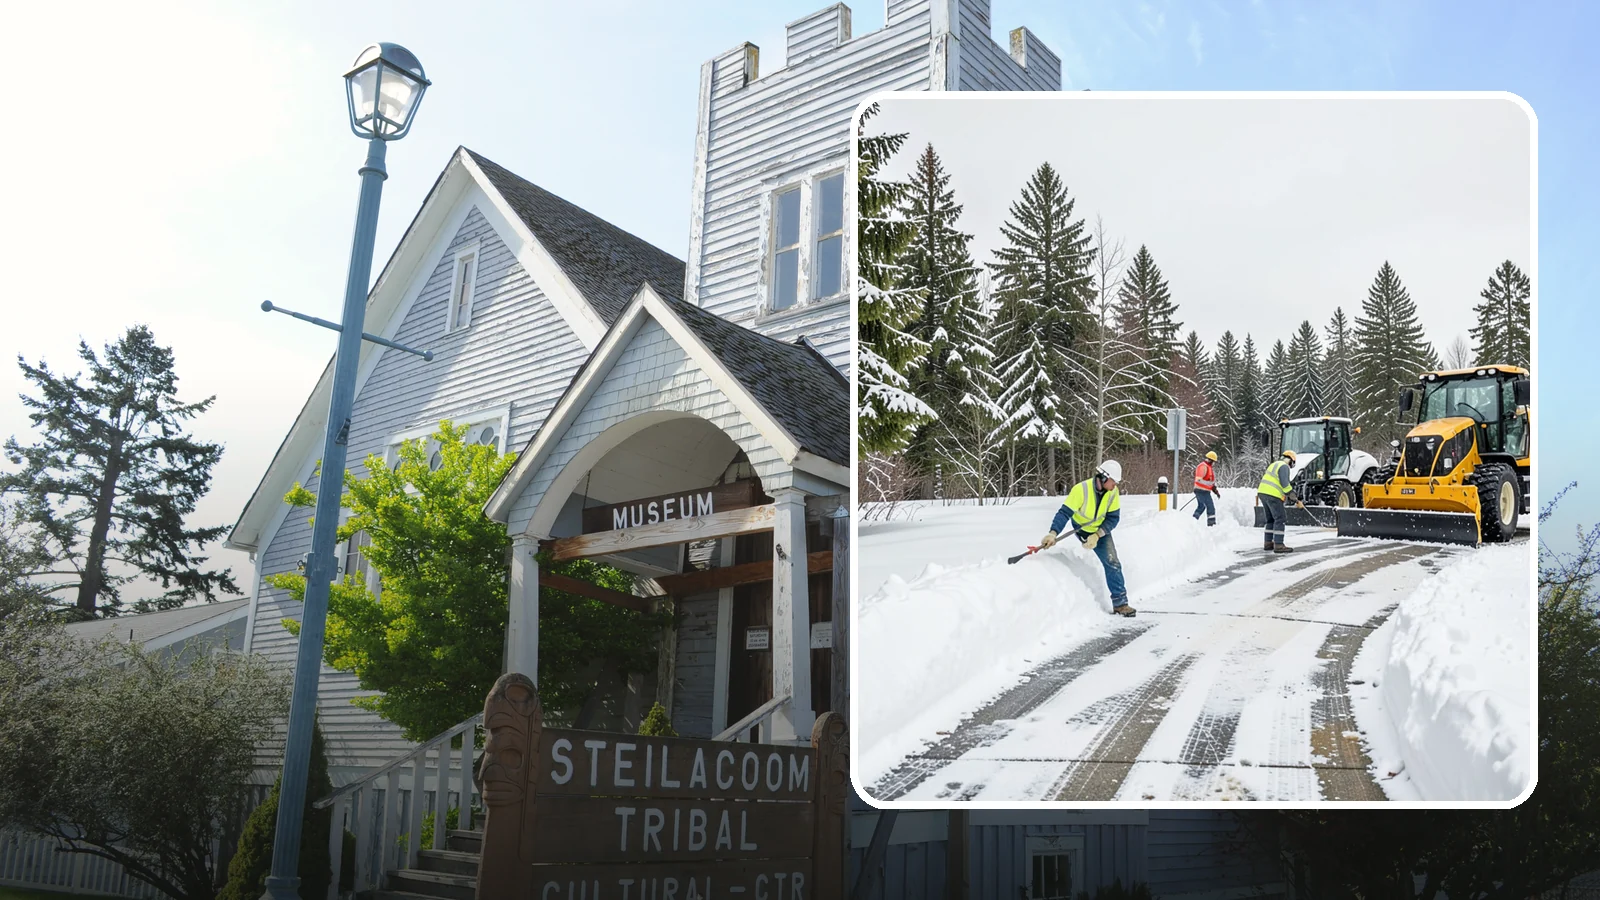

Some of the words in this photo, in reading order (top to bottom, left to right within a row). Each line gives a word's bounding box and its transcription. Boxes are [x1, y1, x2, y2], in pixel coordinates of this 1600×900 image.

[613, 491, 713, 530] MUSEUM
[550, 738, 810, 792] STEILACOOM
[615, 806, 757, 852] TRIBAL
